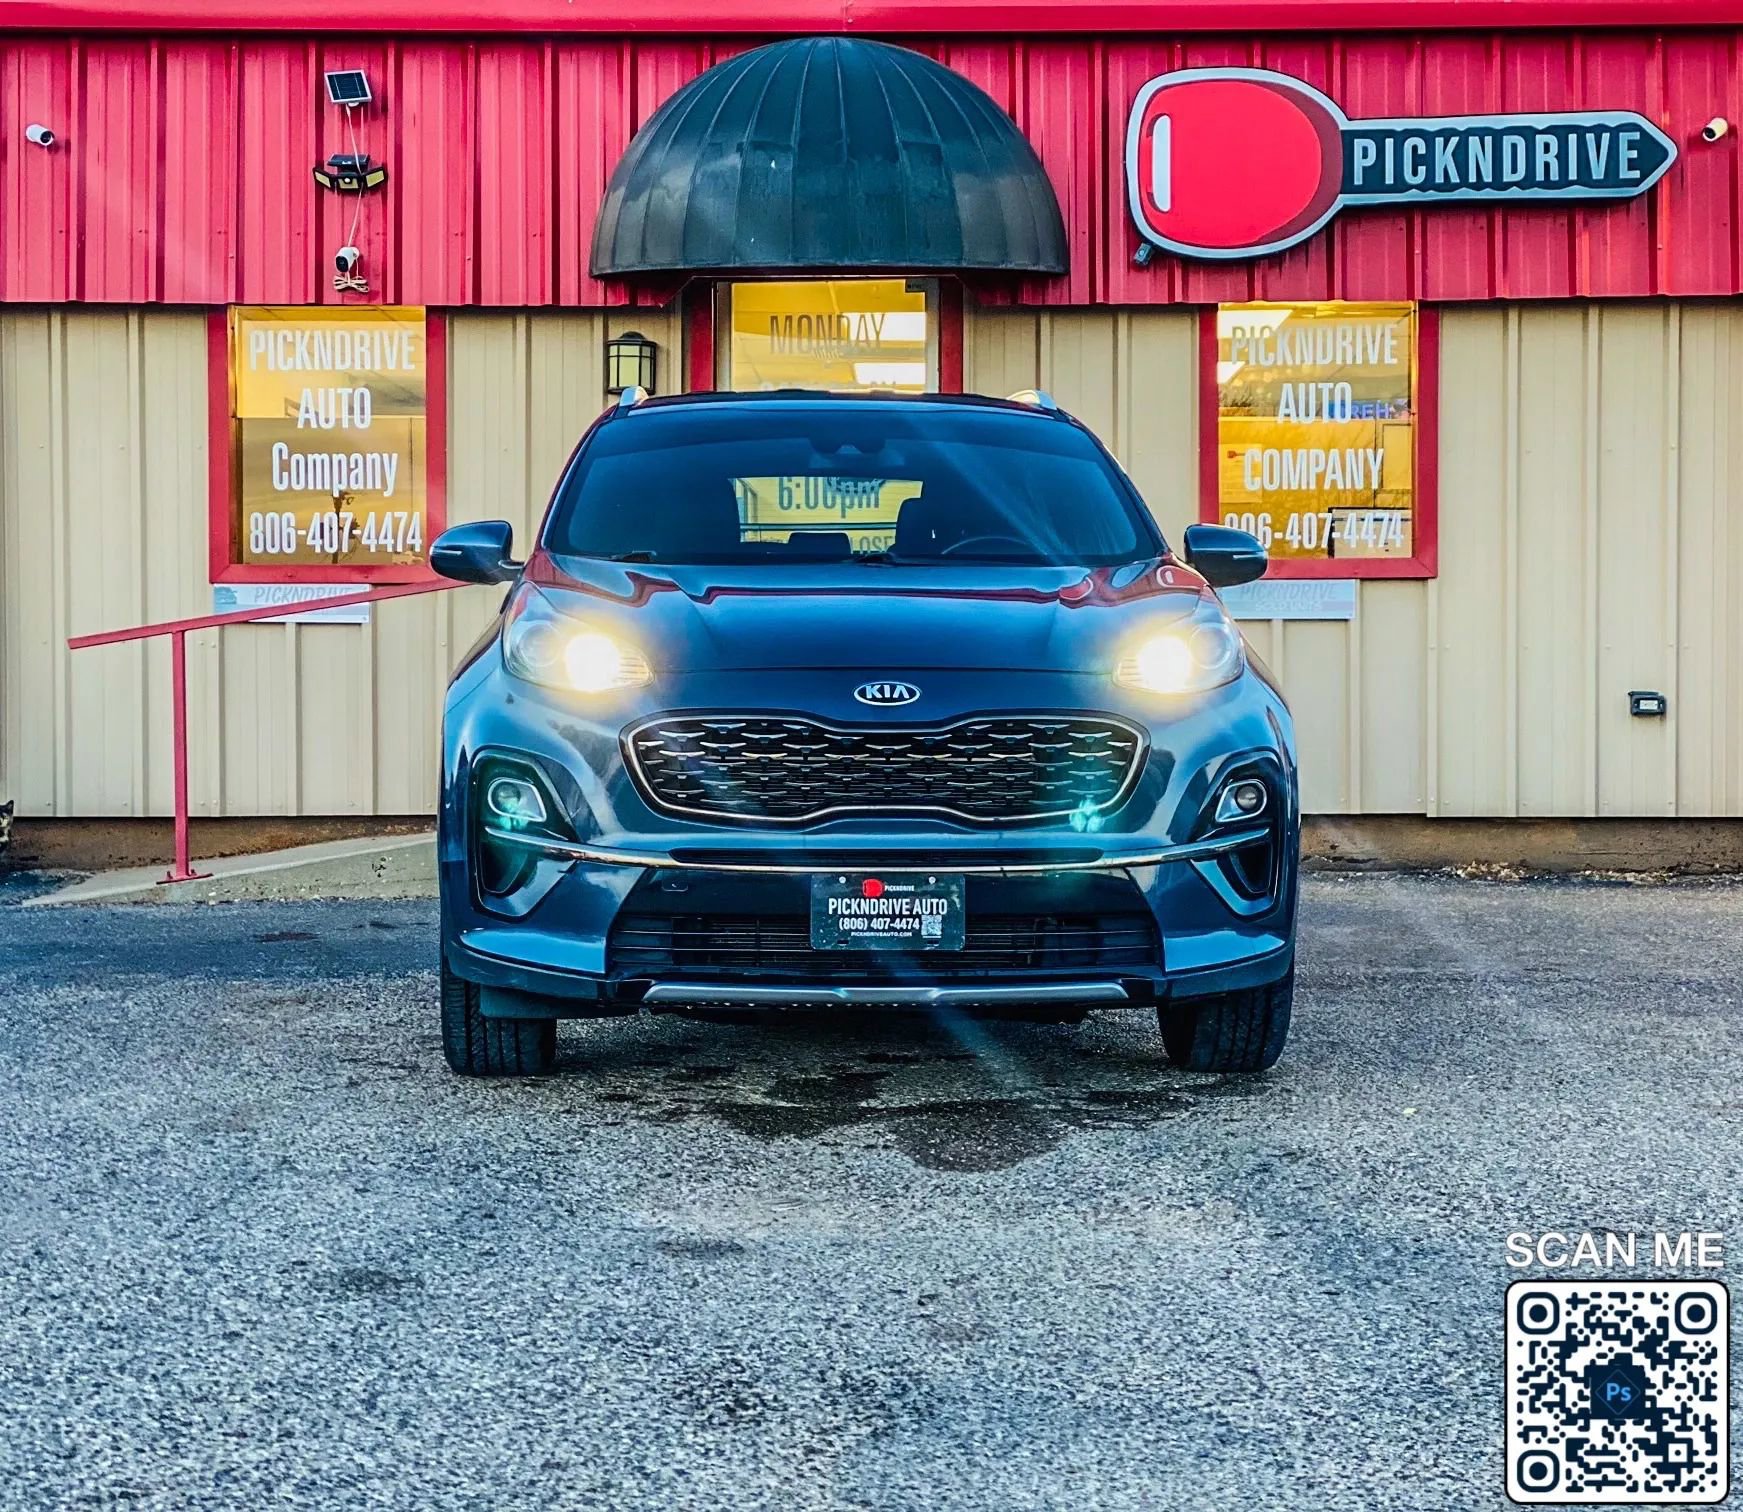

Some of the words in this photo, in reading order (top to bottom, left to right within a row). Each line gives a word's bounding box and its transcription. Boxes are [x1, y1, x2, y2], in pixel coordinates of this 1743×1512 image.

[1353, 131, 1641, 185] PICKNDRIVE
[249, 329, 415, 371] PICKNDRIVE
[769, 313, 885, 354] MONDAY
[1231, 324, 1398, 366] PICKNDRIVE
[297, 387, 373, 429] AUTO
[1277, 381, 1353, 424] AUTO
[271, 441, 398, 497] Company
[1244, 447, 1384, 491] COMPANY
[249, 512, 422, 554] 806-407-4474
[865, 684, 910, 699] KIA
[828, 898, 910, 915] PICKNDRIVE
[912, 898, 948, 915] AUTO
[839, 917, 868, 930] (806)
[870, 917, 920, 930] 407-4474
